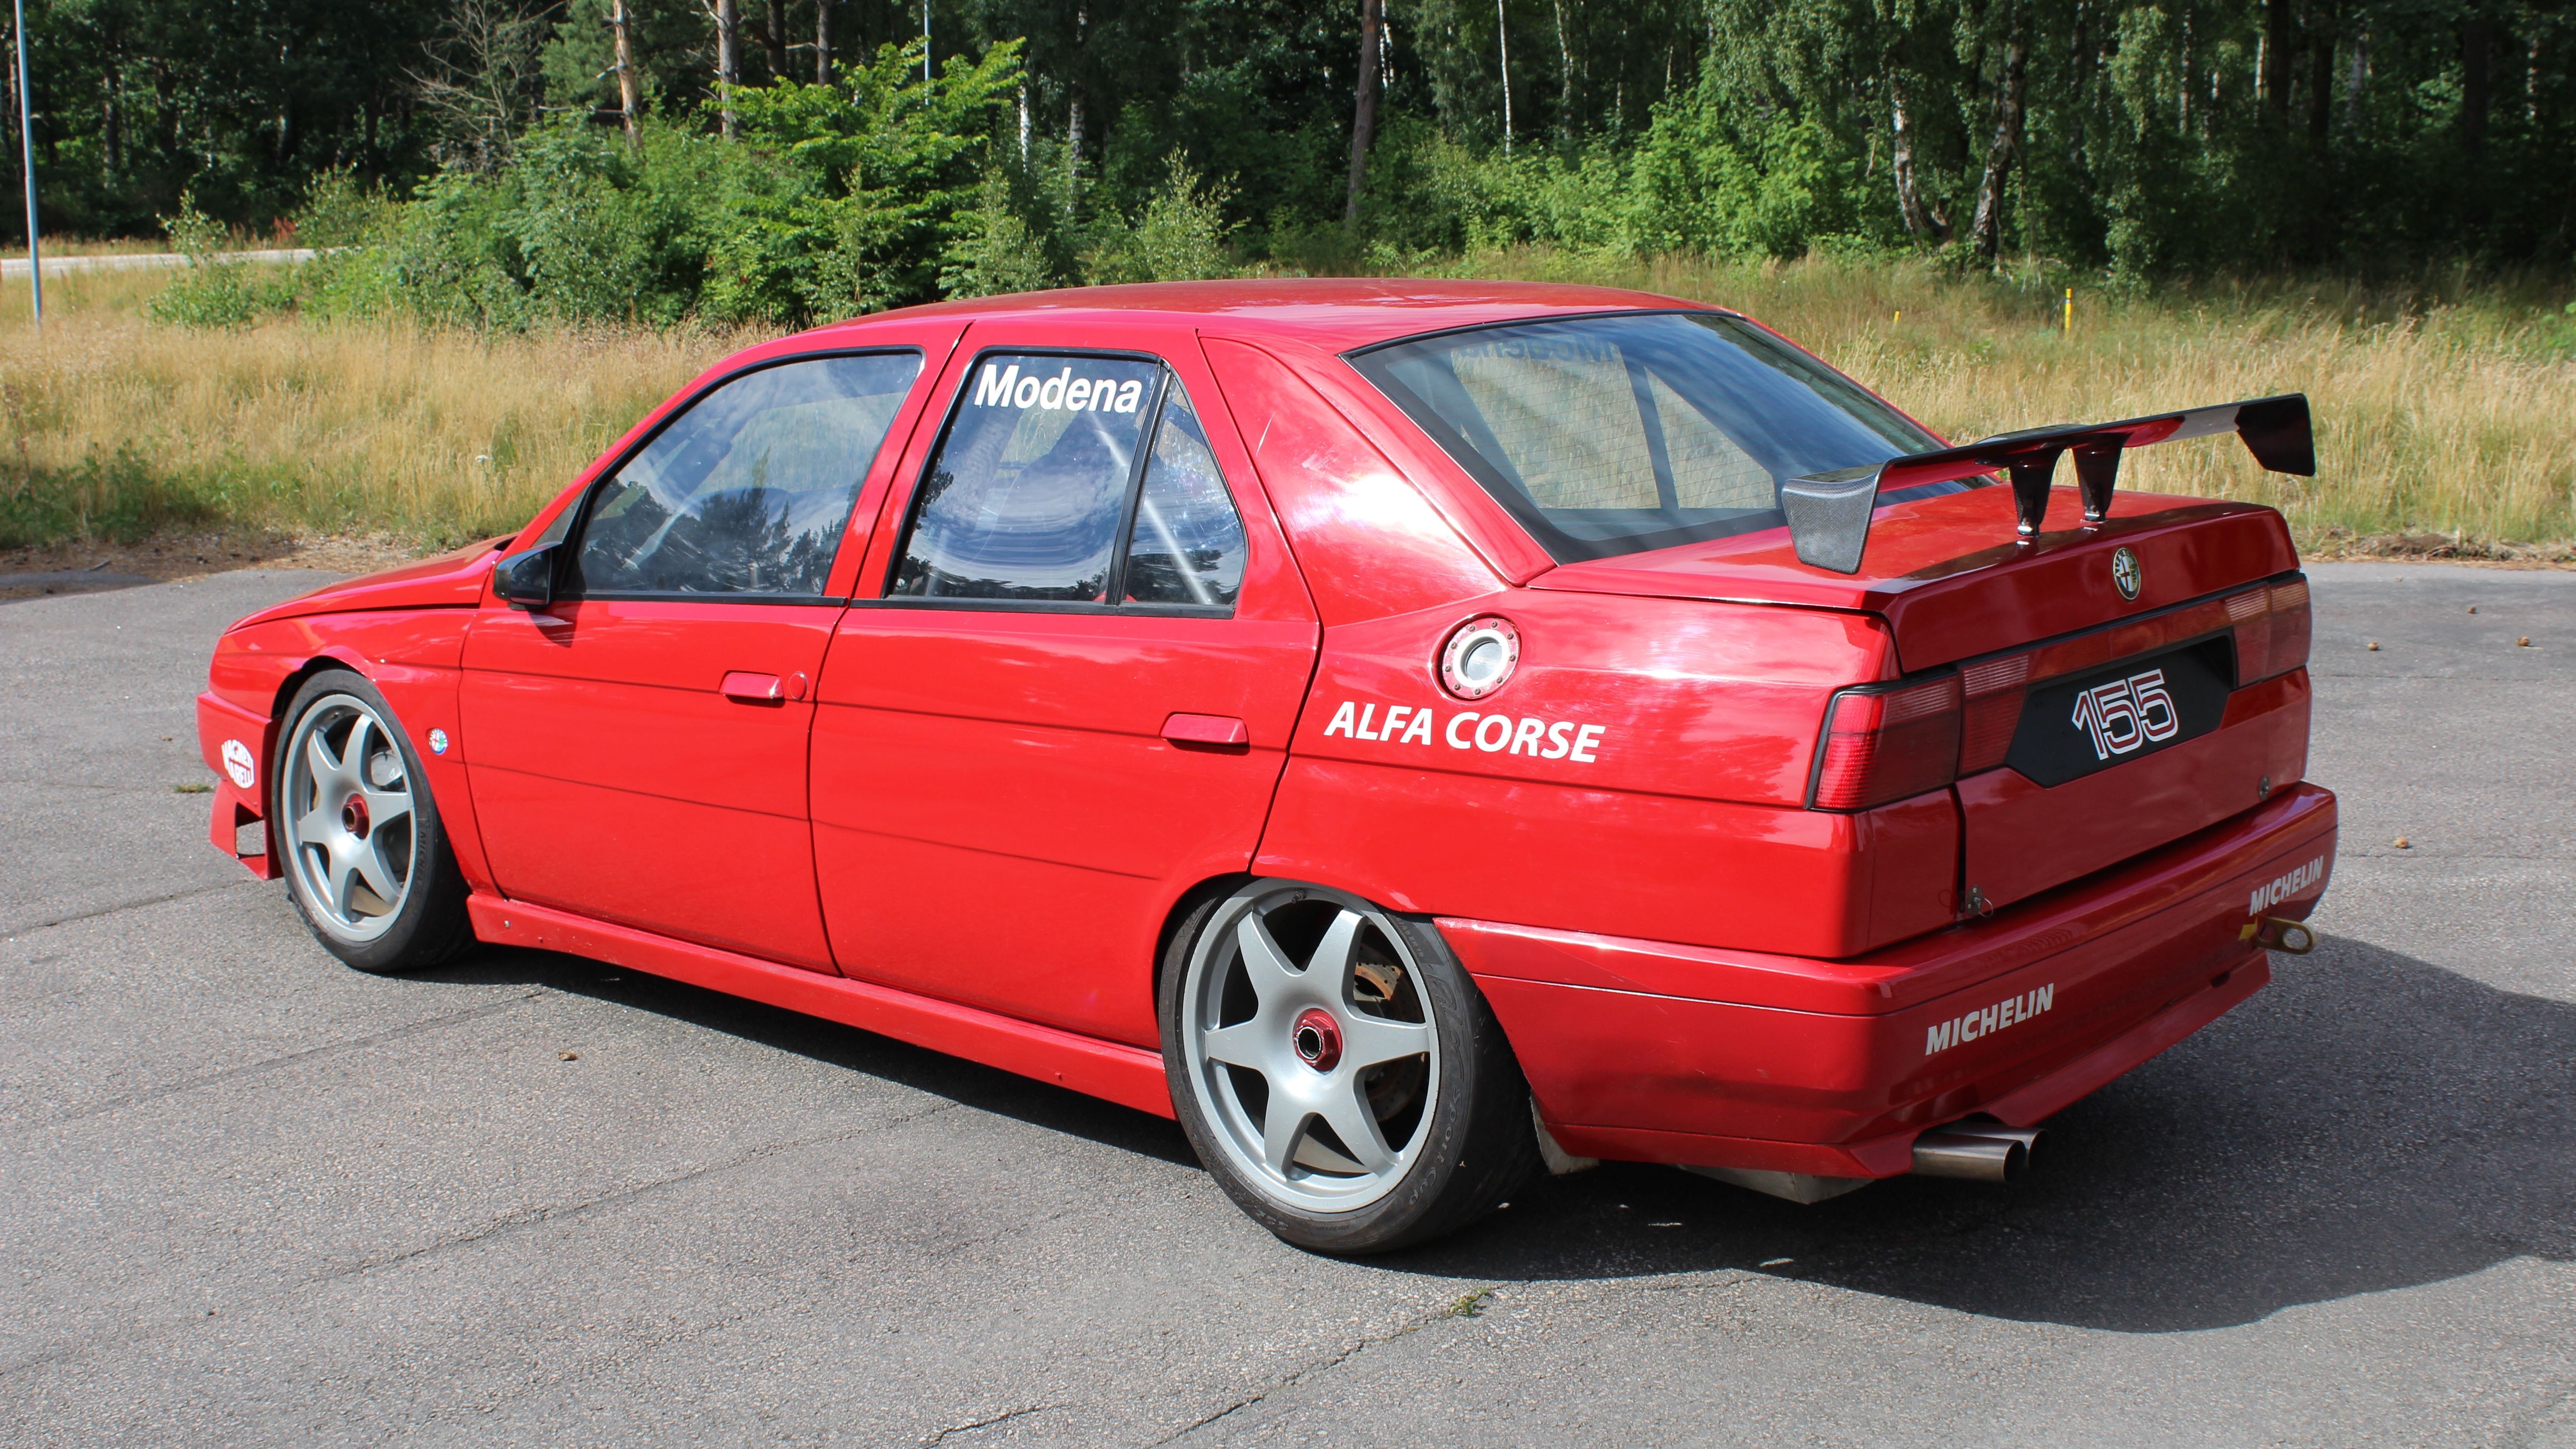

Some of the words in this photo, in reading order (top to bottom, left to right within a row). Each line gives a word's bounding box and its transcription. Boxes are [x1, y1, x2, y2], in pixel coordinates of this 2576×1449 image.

[974, 364, 1142, 413] Modena
[1324, 701, 1432, 745] ALFA
[1446, 712, 1606, 763] CORSE
[2072, 669, 2178, 760] 155
[2250, 855, 2324, 916] MICHELIN
[1926, 983, 2054, 1055] MICHELIN
[1436, 1085, 1463, 1166] Sport
[1408, 1167, 1437, 1206] Cup
